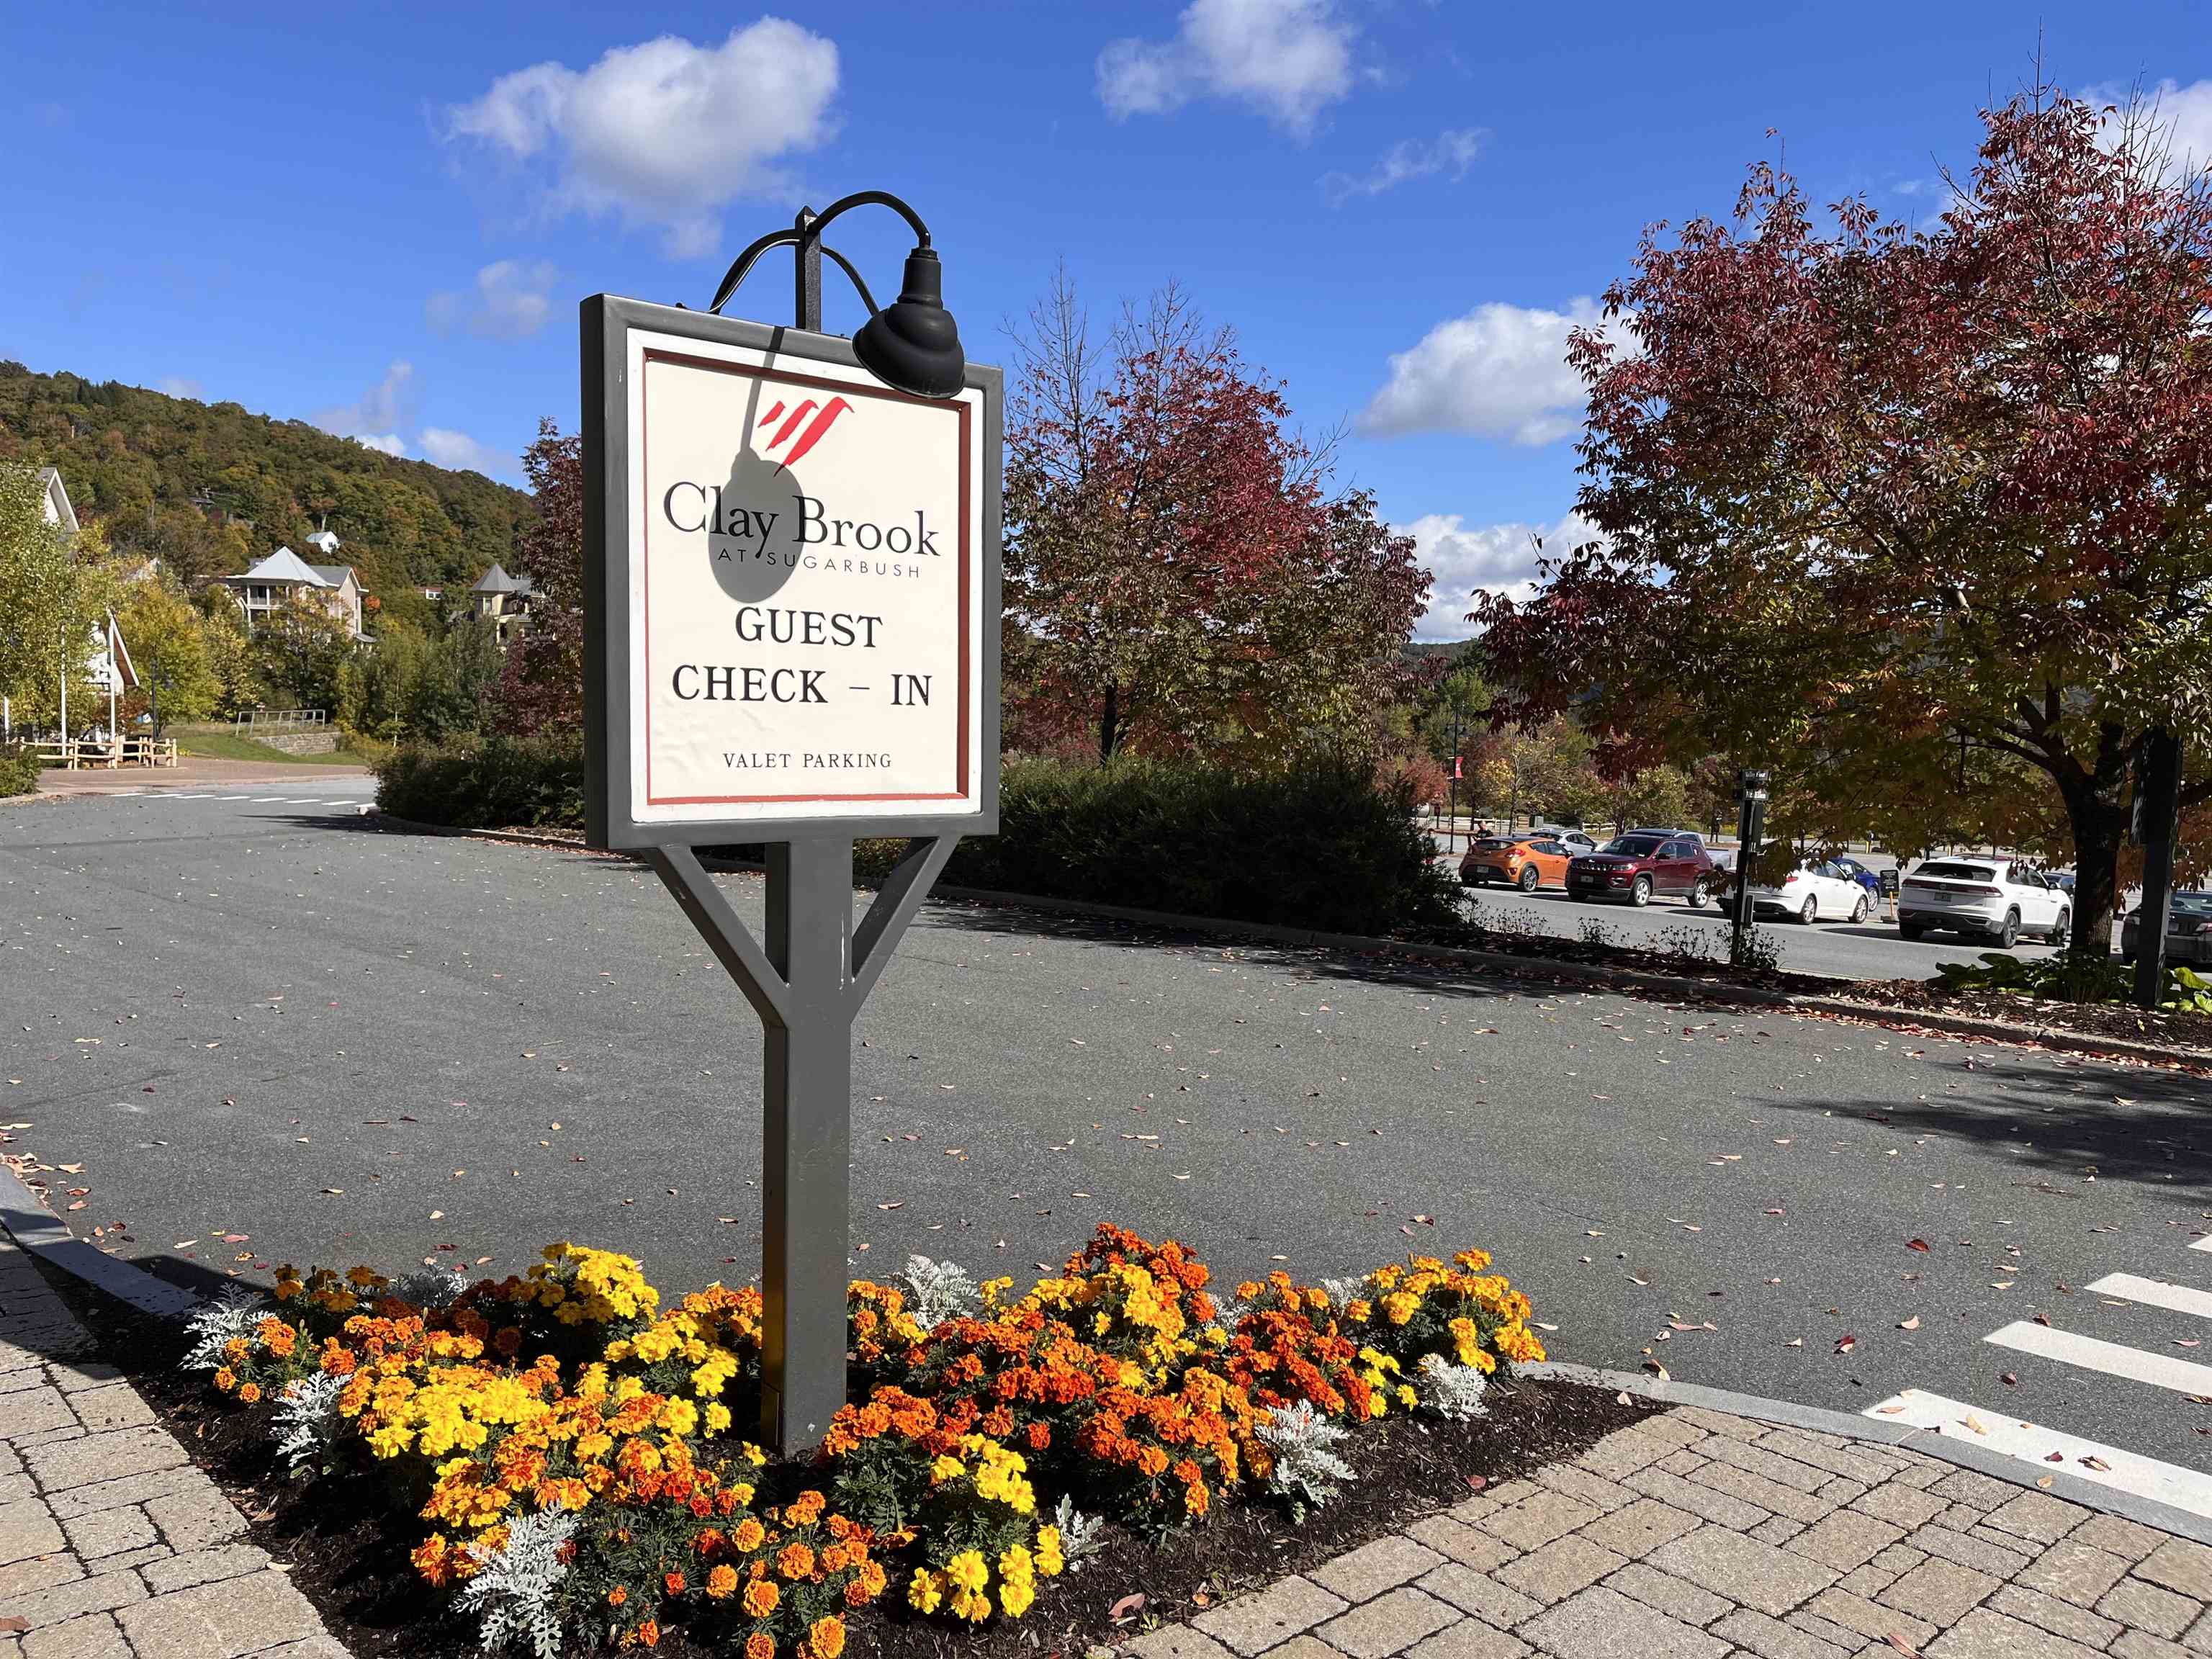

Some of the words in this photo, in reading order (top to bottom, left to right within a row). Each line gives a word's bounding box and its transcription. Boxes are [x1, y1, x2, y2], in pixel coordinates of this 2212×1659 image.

[663, 482, 779, 559] Clay
[792, 495, 941, 557] Brook
[717, 547, 747, 563] AT
[767, 552, 921, 578] SUGARBUSH
[735, 606, 884, 648] GUEST
[673, 664, 829, 703] CHECK
[890, 673, 932, 706] IN
[723, 753, 791, 768] VALET
[804, 753, 891, 768] PARKING
